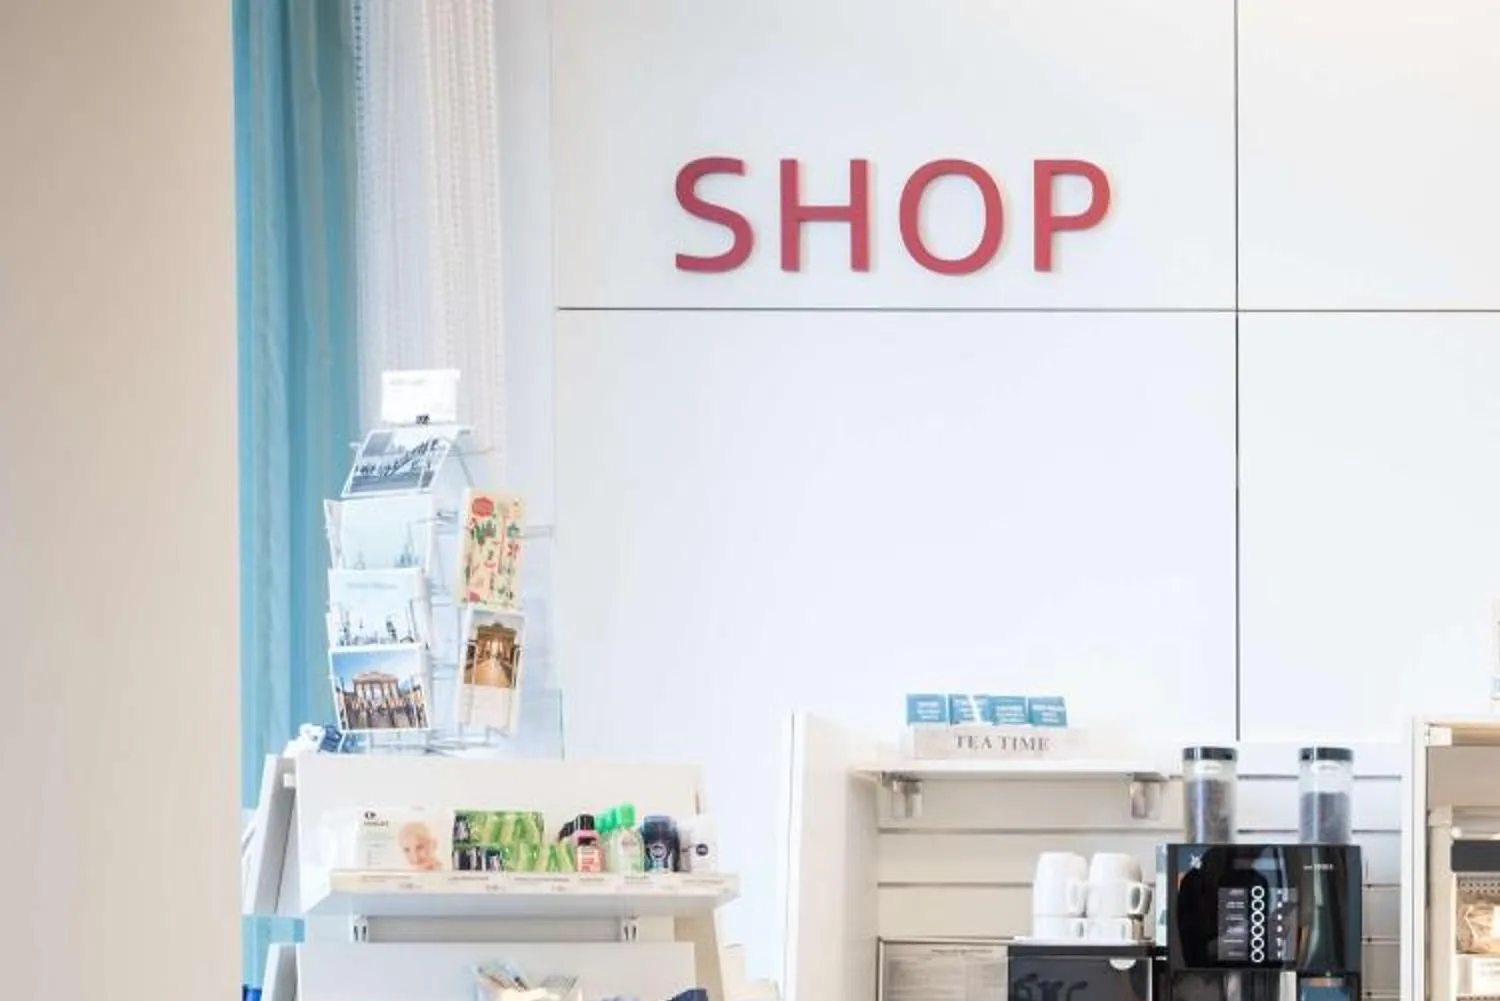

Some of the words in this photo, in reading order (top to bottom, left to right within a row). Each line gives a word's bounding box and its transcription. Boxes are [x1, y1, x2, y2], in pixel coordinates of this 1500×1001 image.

[676, 156, 1111, 275] SHOP
[955, 735, 992, 750] TEA
[998, 735, 1050, 752] TIME
